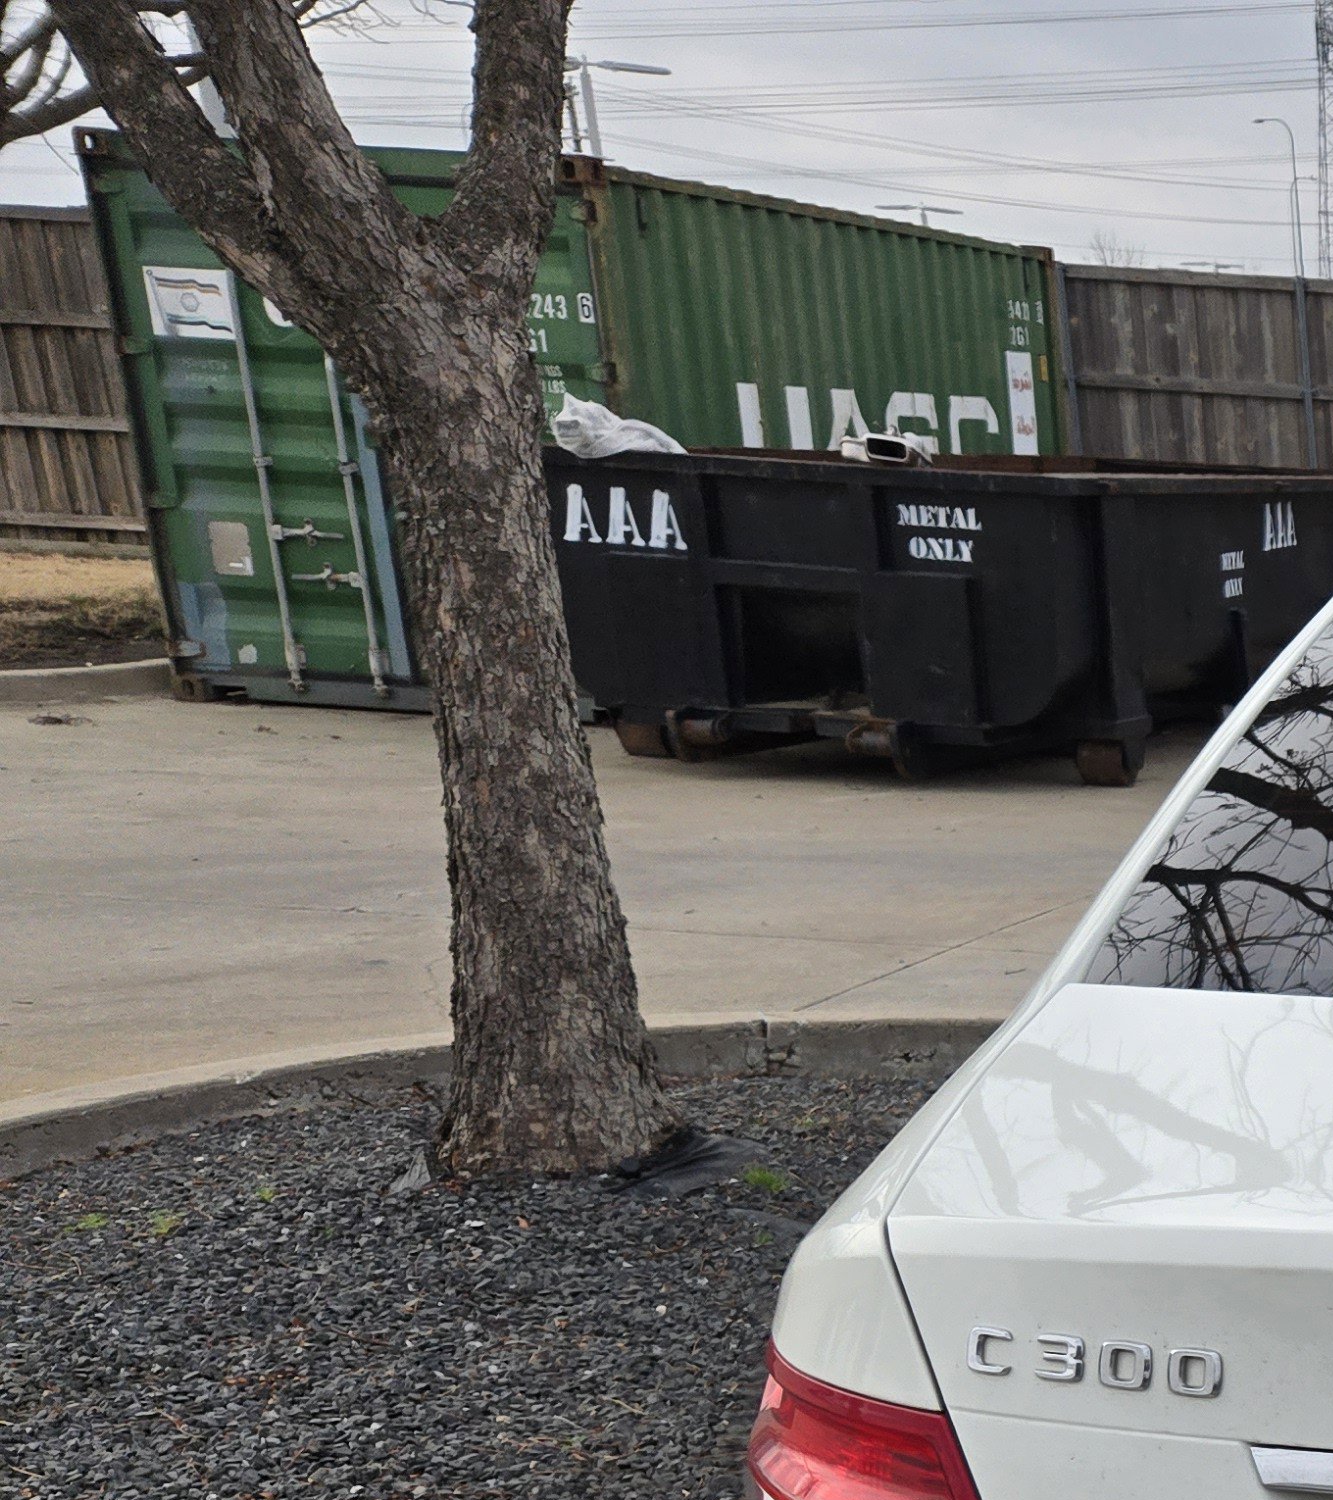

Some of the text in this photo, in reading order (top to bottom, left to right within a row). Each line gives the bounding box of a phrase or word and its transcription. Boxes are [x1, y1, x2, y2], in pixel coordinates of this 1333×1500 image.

[525, 293, 568, 320] 243
[563, 483, 688, 551] AAA
[896, 504, 982, 530] METAL
[1263, 501, 1298, 551] AAA
[909, 536, 974, 563] ONLY
[966, 1325, 1223, 1398] C 300
